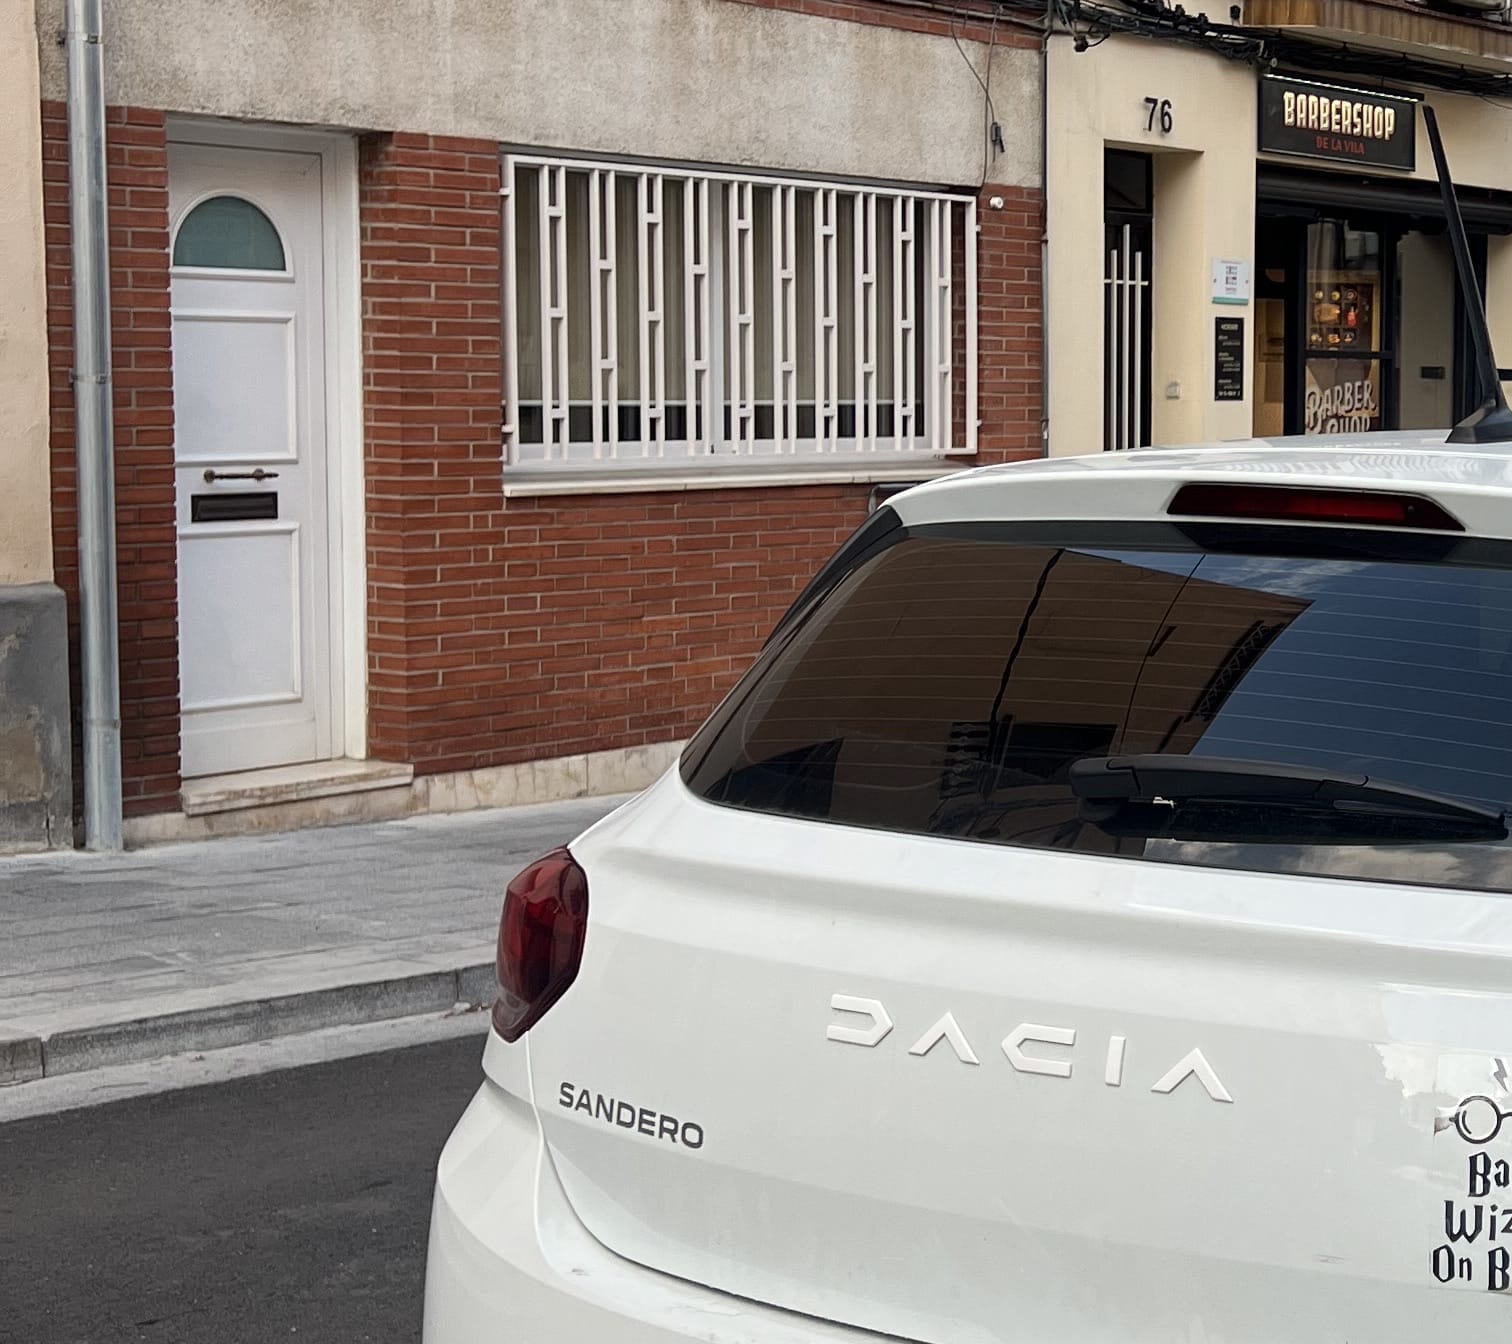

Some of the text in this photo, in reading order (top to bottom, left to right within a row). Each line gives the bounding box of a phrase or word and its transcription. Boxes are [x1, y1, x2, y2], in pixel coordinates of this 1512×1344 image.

[1143, 96, 1173, 134] 76
[1283, 91, 1396, 141] BARBERSHOP
[1316, 136, 1365, 154] DE LA VILA
[1305, 380, 1377, 434] BARBER
[826, 993, 1233, 1103] DACIA
[559, 1081, 705, 1150] SANDERO
[1432, 1244, 1472, 1283] On
